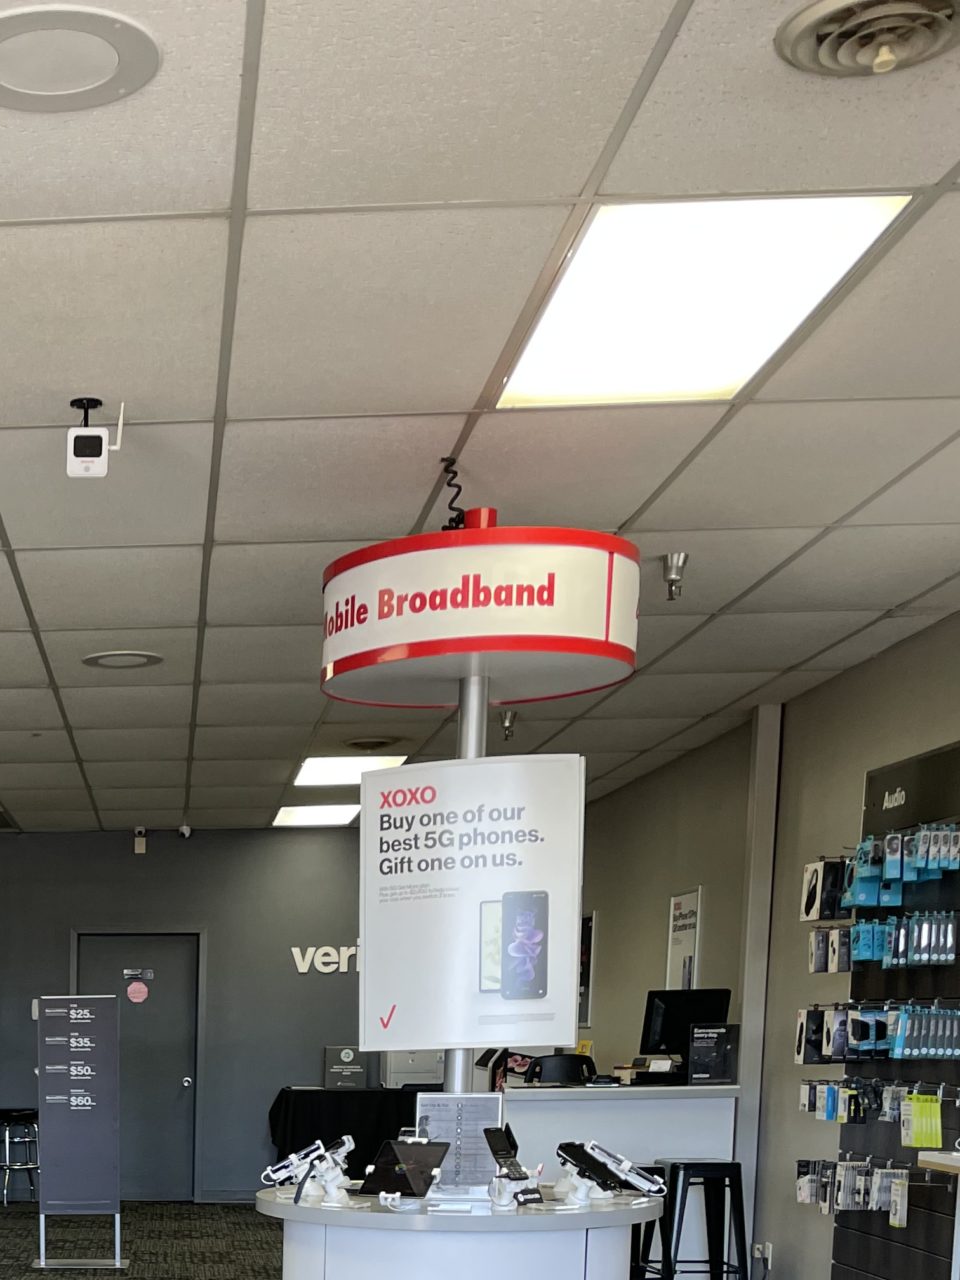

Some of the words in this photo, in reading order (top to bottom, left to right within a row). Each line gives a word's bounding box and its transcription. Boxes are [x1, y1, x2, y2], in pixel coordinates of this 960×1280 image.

[377, 572, 556, 620] Broadband
[379, 785, 437, 809] XOXO
[882, 787, 906, 810] Audio
[379, 813, 416, 832] Buy
[419, 810, 459, 827] one
[462, 804, 486, 823] of
[488, 806, 526, 822] our
[379, 833, 420, 853] best
[423, 829, 455, 849] 5G
[458, 827, 545, 850] phones.
[379, 857, 413, 875] Gift
[417, 855, 456, 871] one
[459, 853, 488, 869] on
[491, 852, 523, 867] us.
